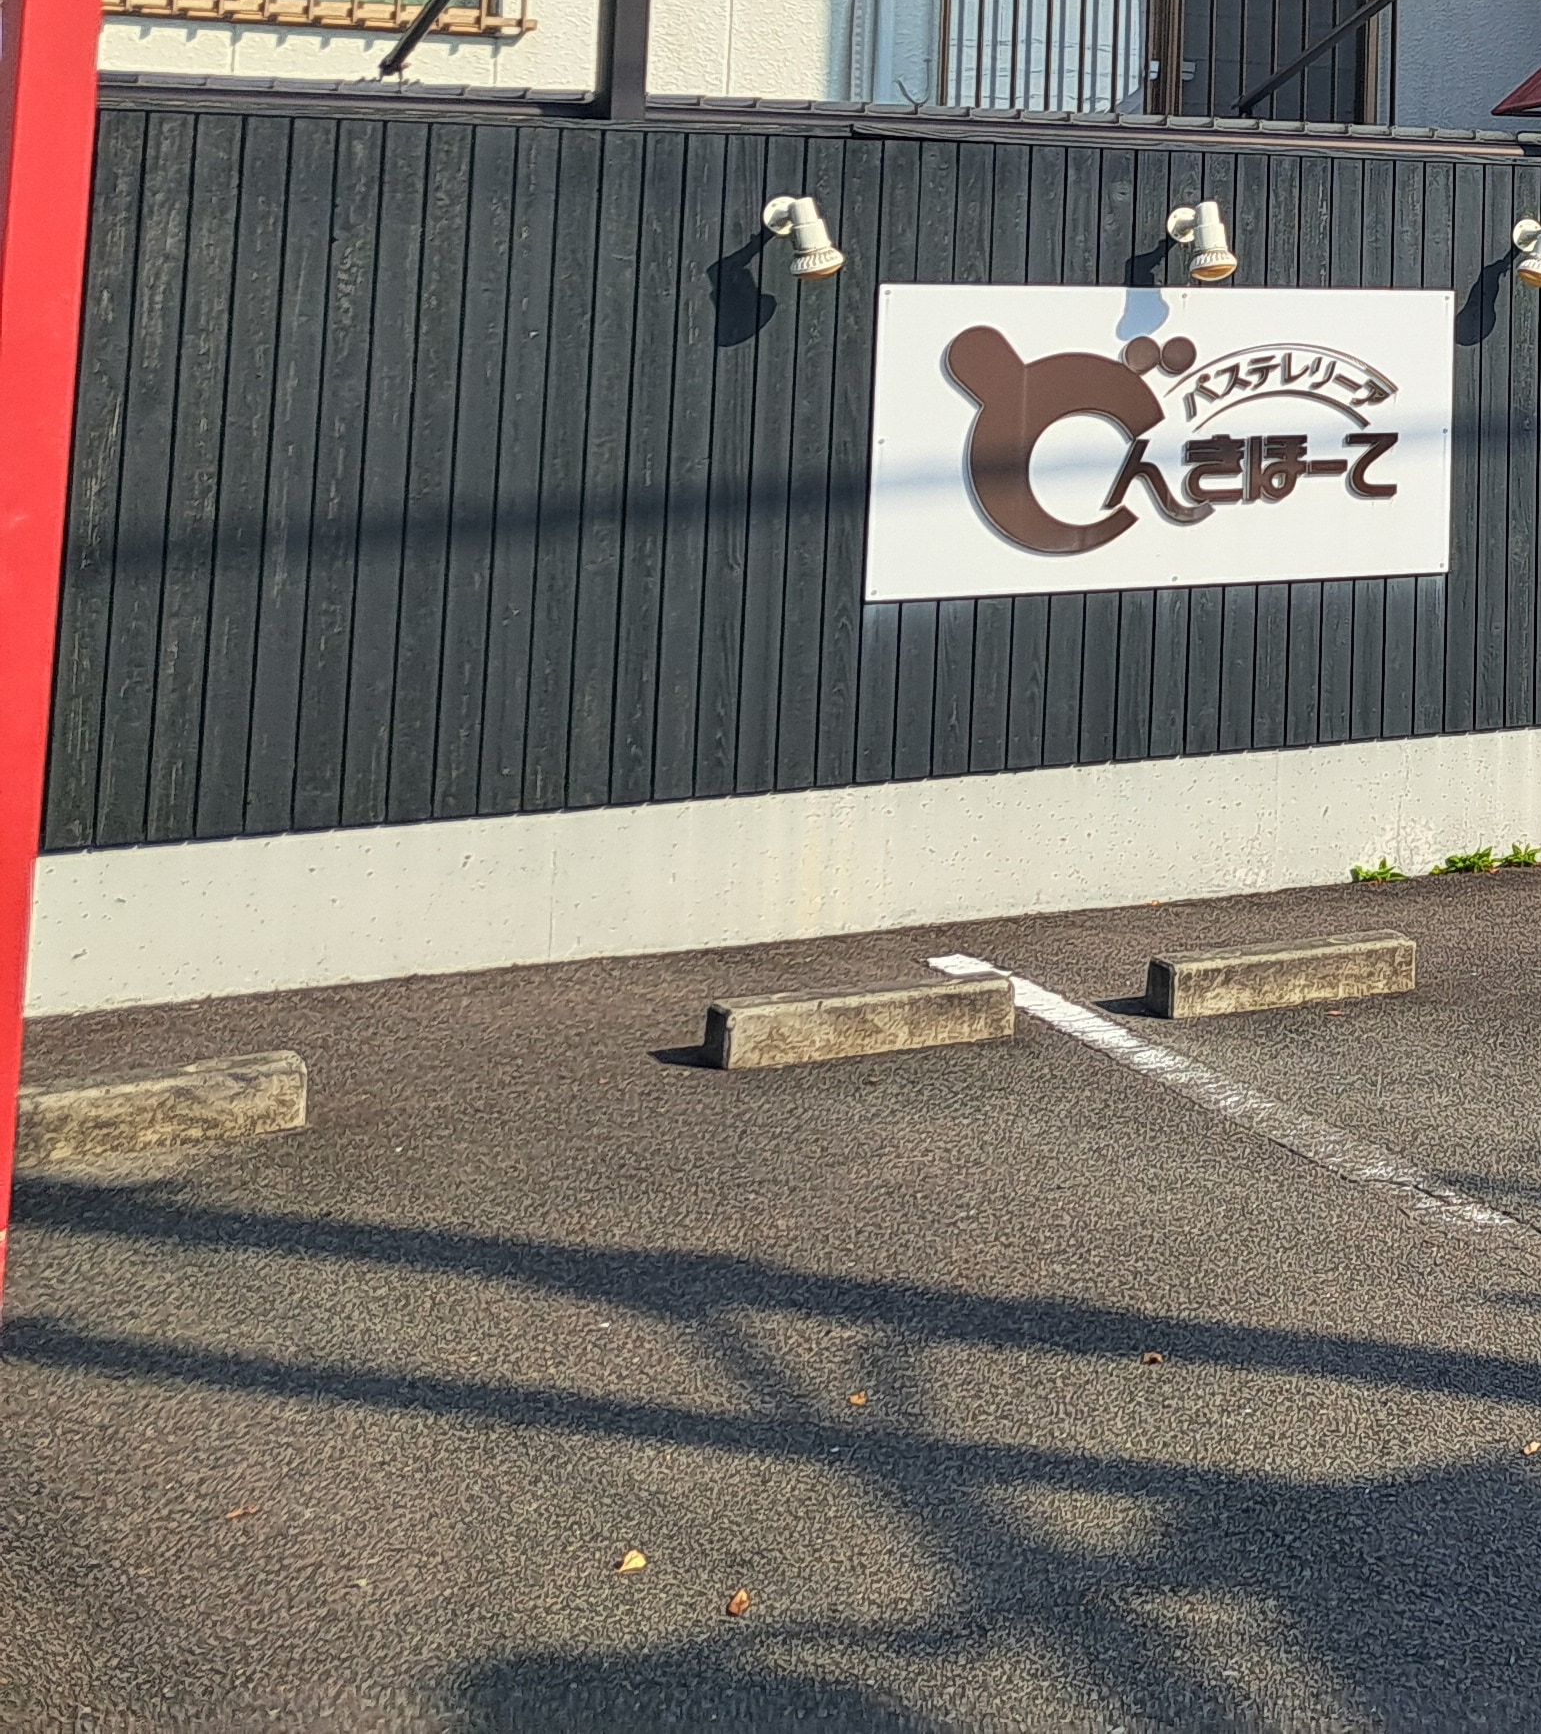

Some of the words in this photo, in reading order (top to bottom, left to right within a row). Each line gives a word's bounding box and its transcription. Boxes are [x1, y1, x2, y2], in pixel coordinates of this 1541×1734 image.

[1184, 352, 1391, 422] パステレリーア
